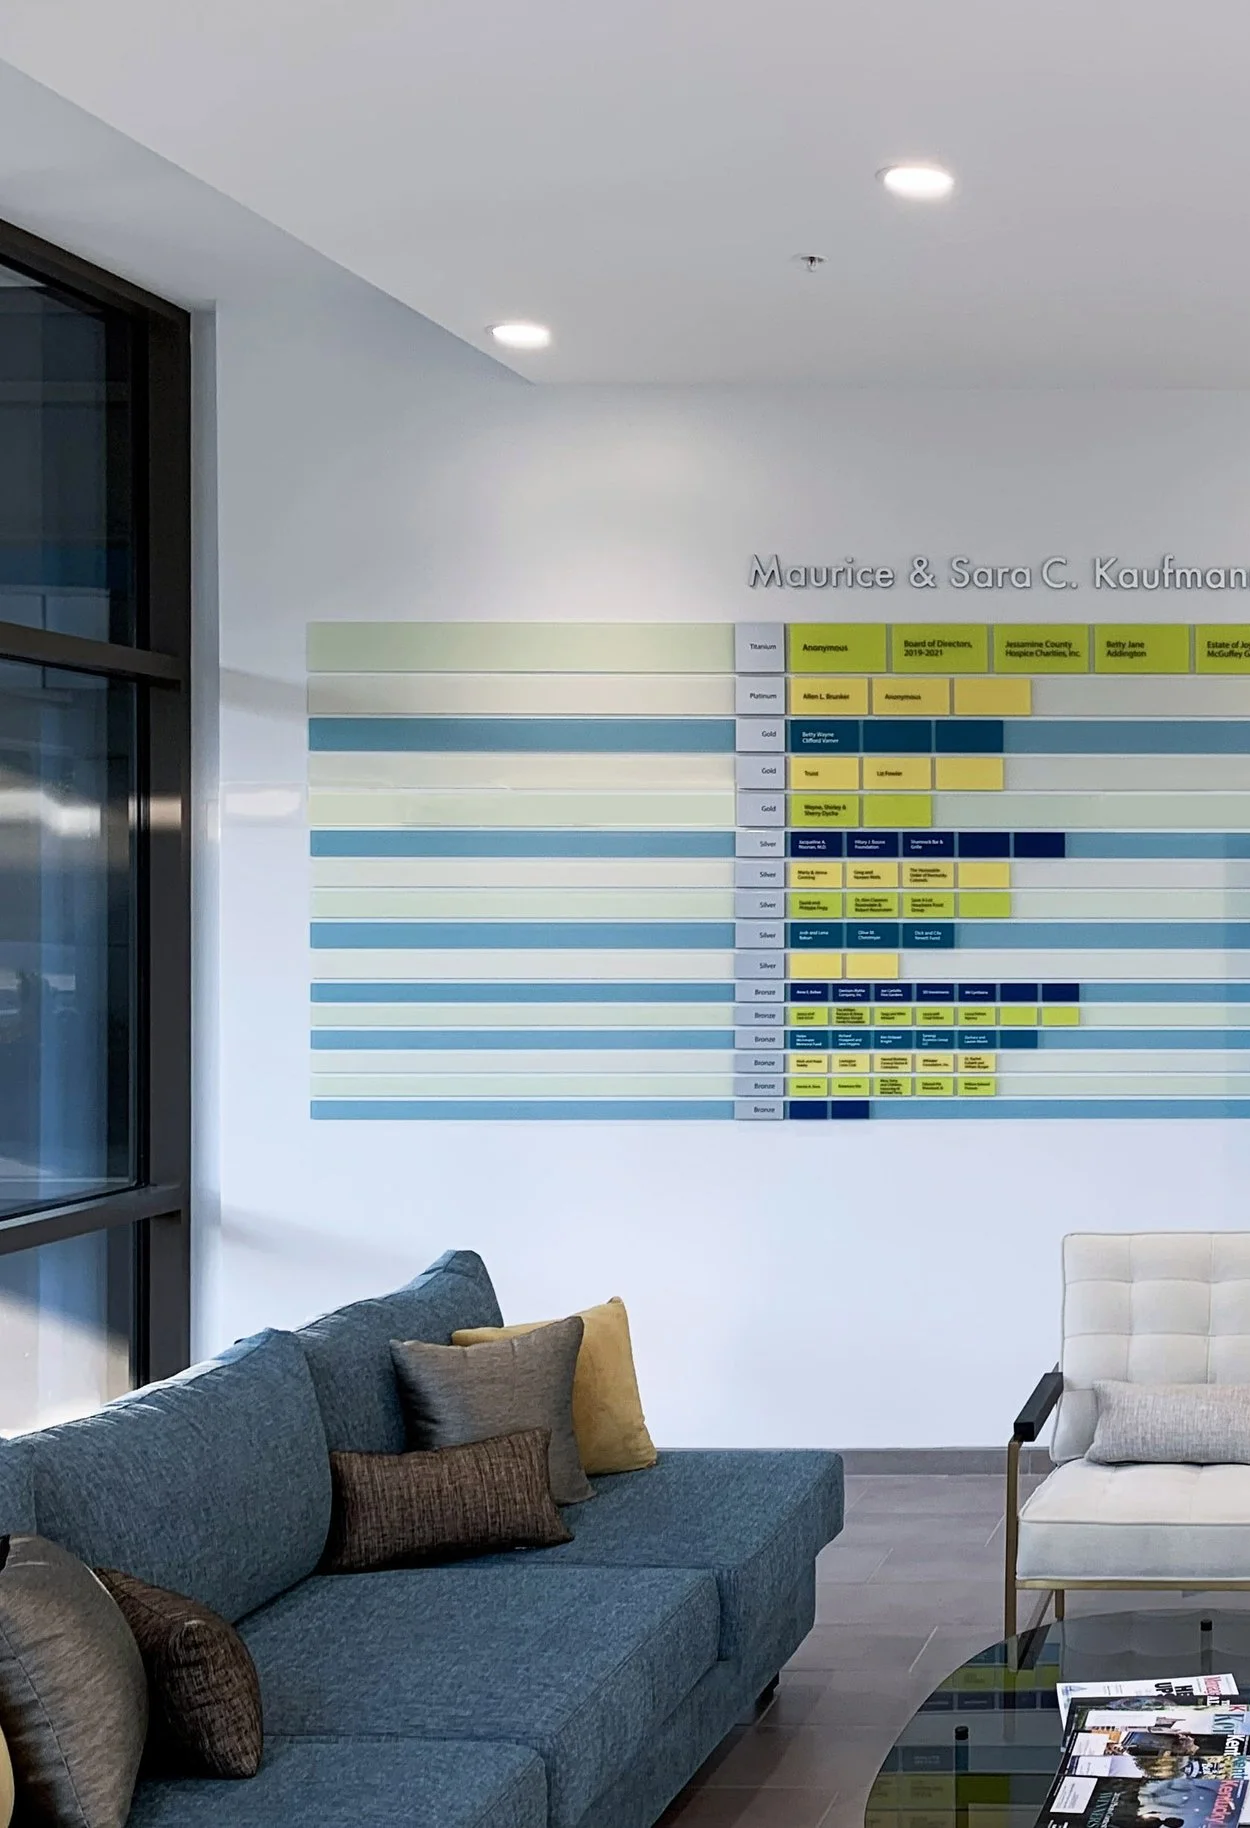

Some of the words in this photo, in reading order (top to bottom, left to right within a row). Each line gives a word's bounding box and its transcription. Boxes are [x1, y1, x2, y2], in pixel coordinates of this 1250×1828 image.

[750, 554, 895, 588] Maurice
[909, 556, 936, 588] &
[951, 556, 1032, 588] Sara
[1042, 556, 1079, 589] C.
[803, 643, 848, 652] Anonymous
[904, 640, 924, 648] Board
[926, 640, 935, 648] of
[936, 640, 972, 649] Directors,
[1045, 641, 1072, 650] County
[1106, 641, 1126, 650] Betty
[1005, 650, 1034, 658] Hospice
[1106, 650, 1147, 659] Addington
[1207, 650, 1243, 659] McGuffey
[885, 693, 921, 701] Anonymous
[1205, 1780, 1240, 1824] Kentucky
